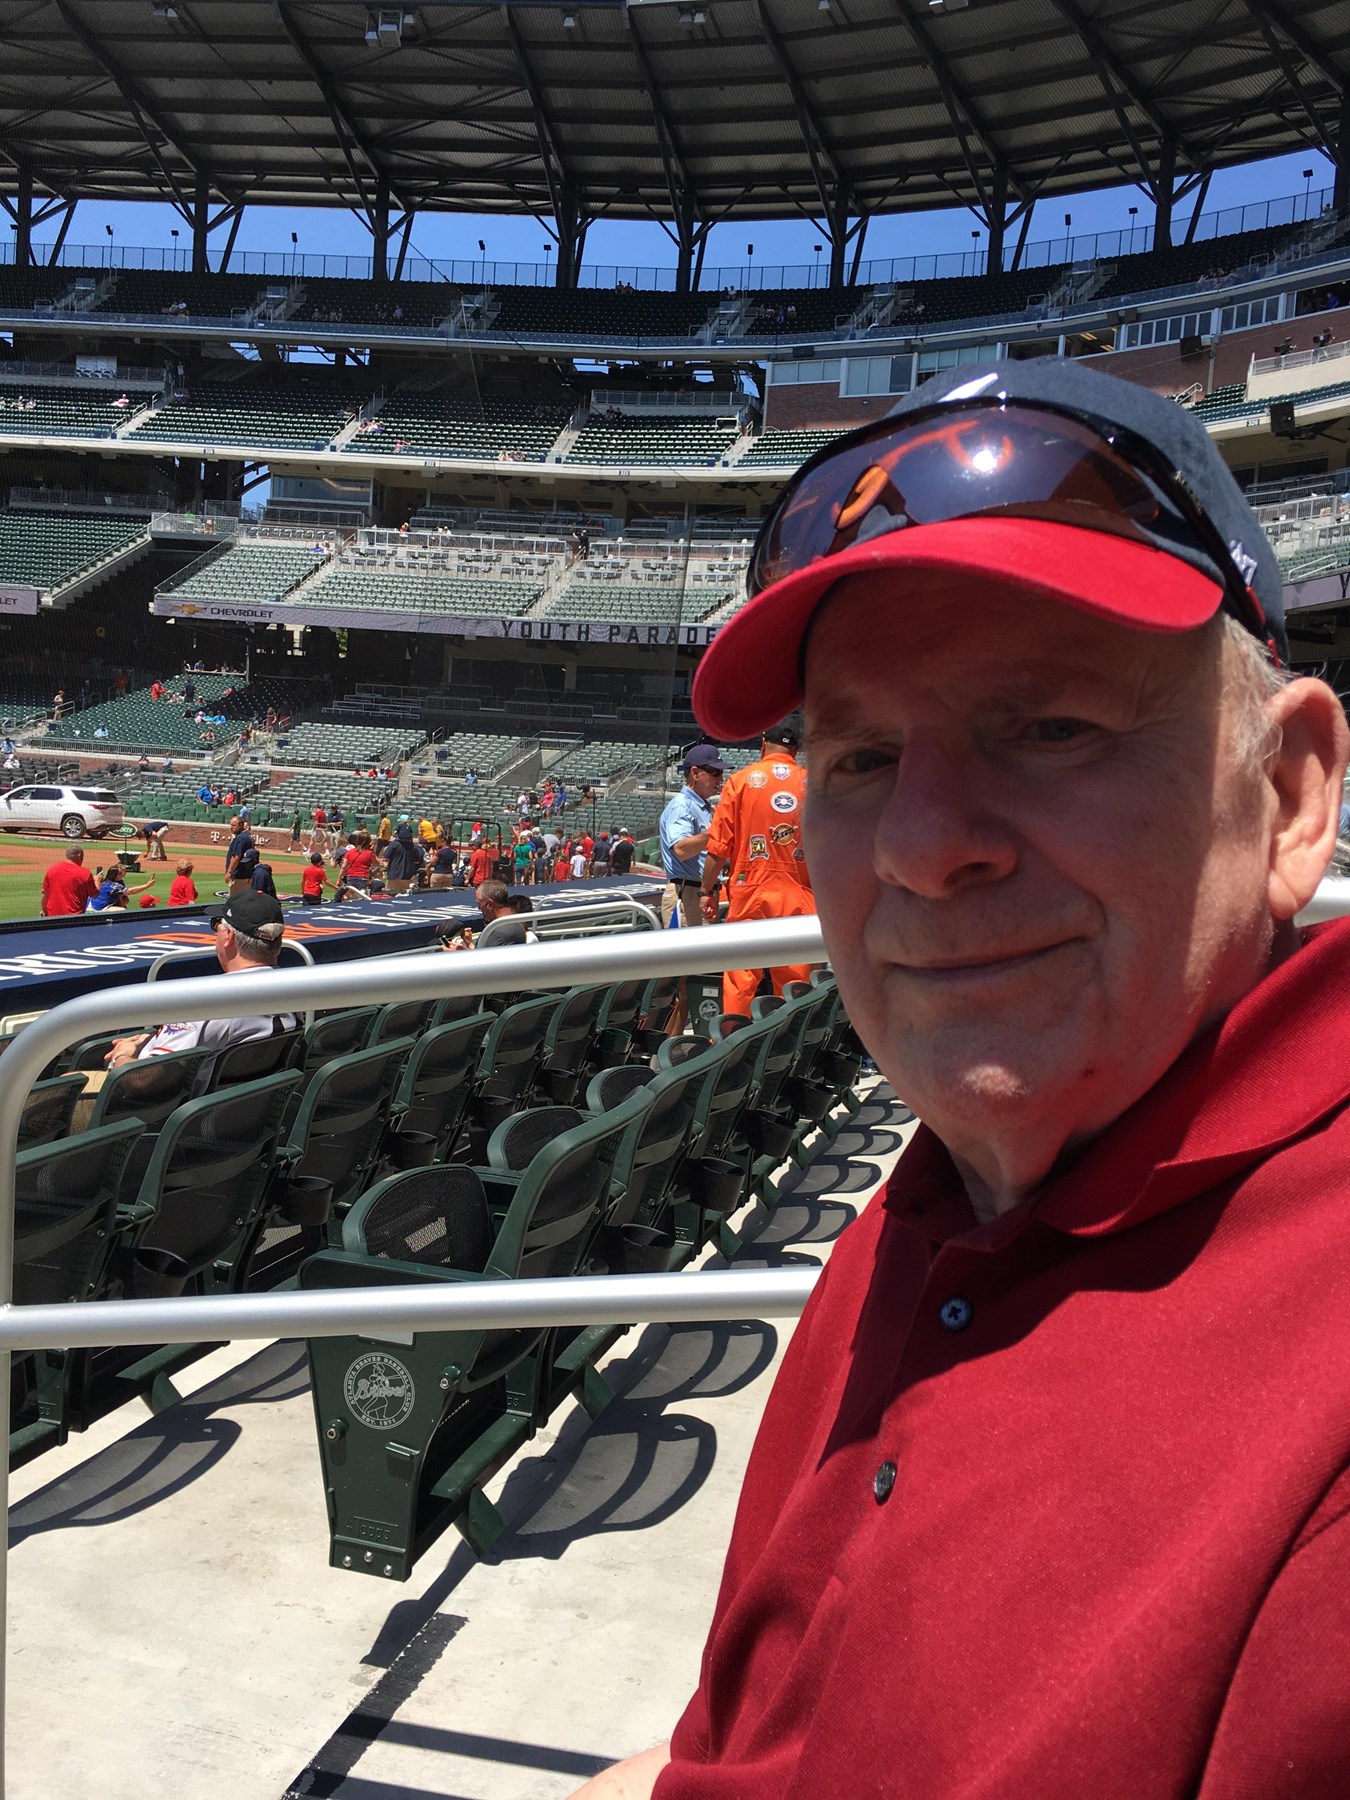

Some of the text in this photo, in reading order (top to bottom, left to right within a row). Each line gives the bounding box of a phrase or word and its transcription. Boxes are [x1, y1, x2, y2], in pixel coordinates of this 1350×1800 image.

[210, 607, 274, 618] CHEVROLET
[501, 620, 718, 645] YOUTH PARADE
[355, 1356, 381, 1370] BRAVES
[383, 1356, 410, 1390] BASEBALL
[402, 1392, 412, 1412] CLUB
